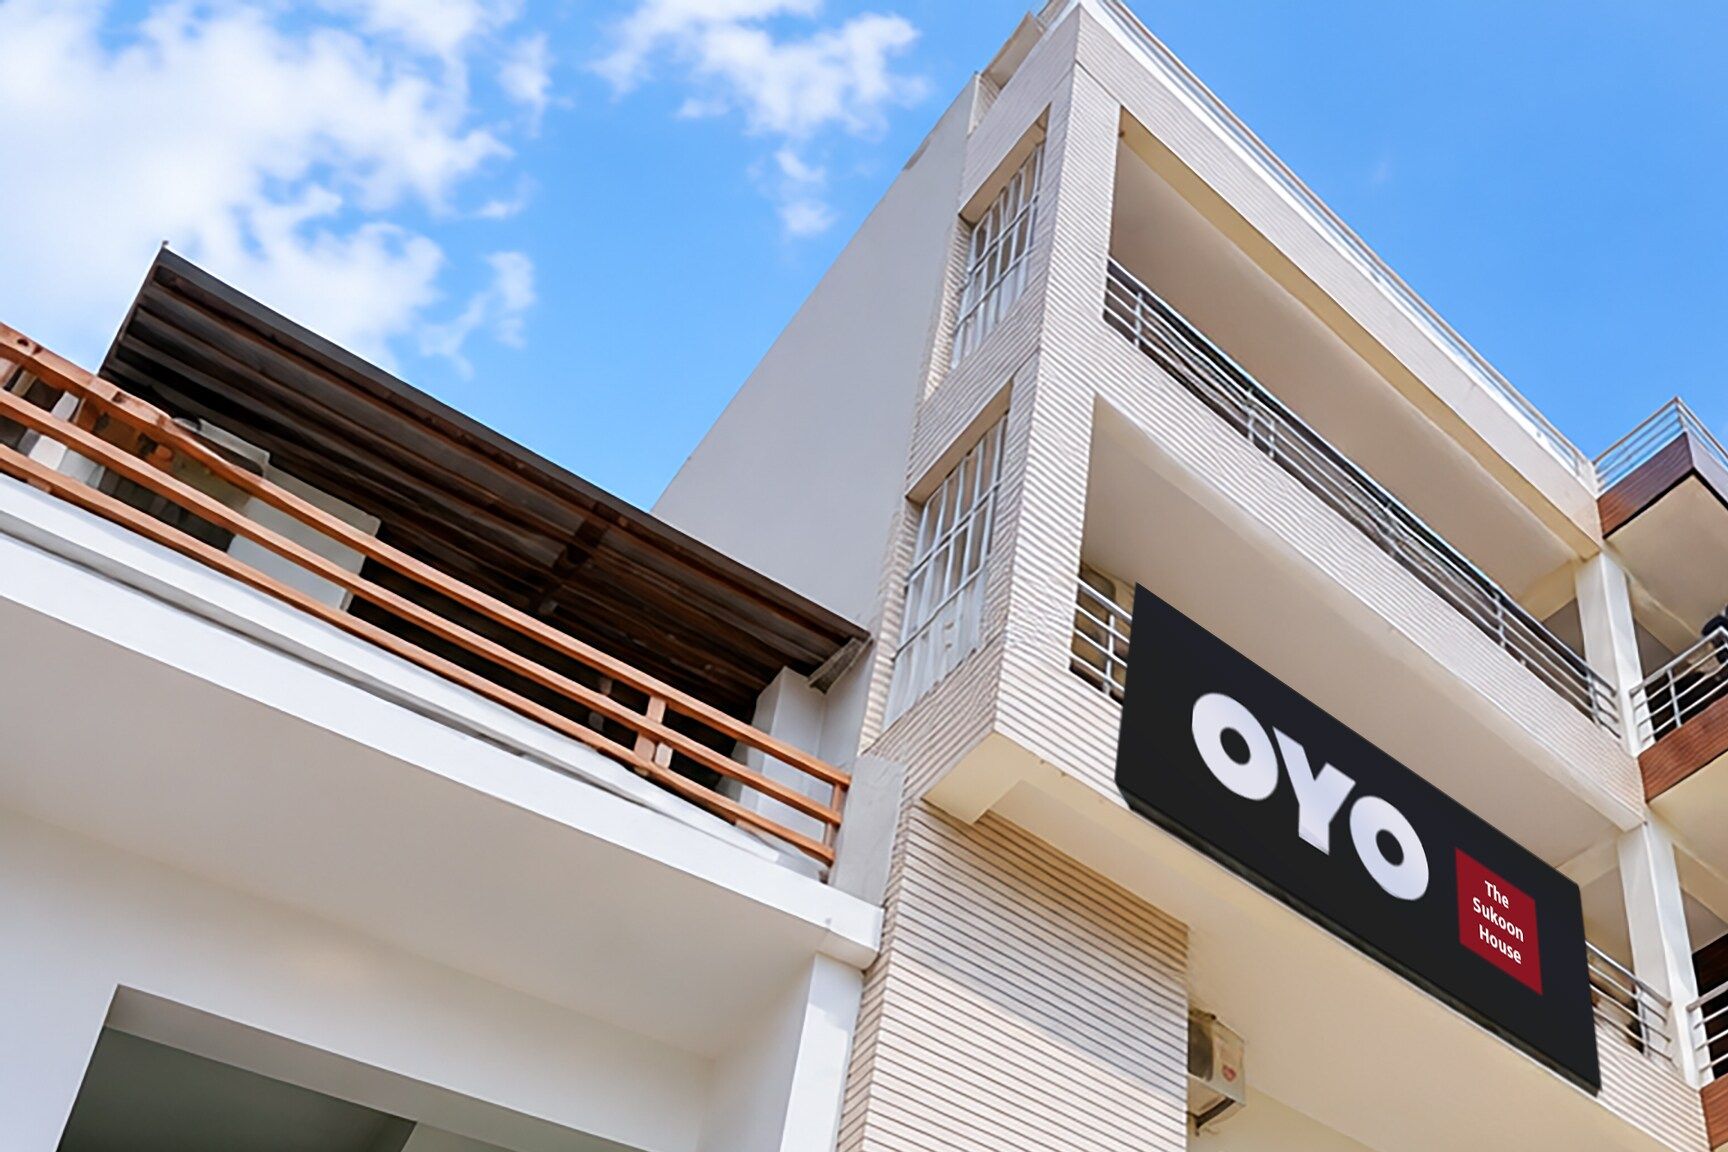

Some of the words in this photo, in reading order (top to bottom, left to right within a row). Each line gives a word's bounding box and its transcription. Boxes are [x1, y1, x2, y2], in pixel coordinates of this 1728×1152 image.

[1192, 692, 1429, 900] OYO
[1485, 880, 1509, 909] The
[1472, 897, 1524, 942] Sukoon
[1479, 924, 1521, 964] House
